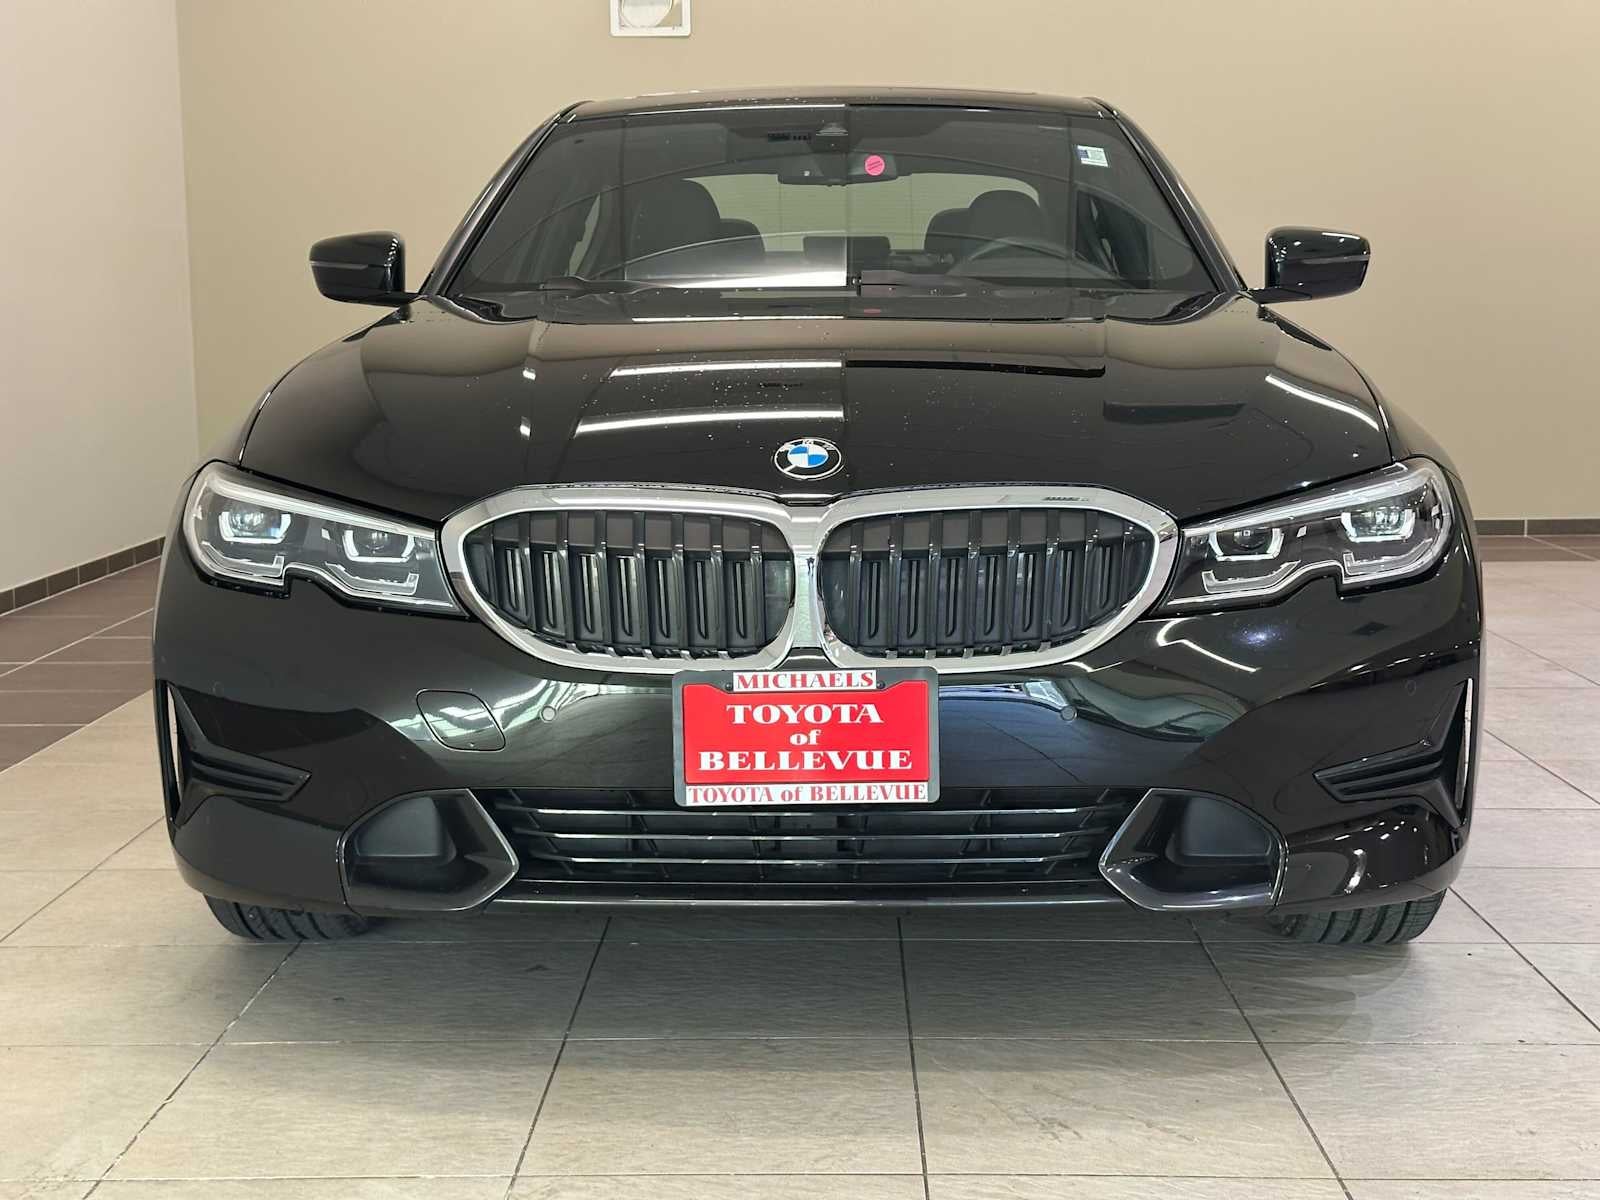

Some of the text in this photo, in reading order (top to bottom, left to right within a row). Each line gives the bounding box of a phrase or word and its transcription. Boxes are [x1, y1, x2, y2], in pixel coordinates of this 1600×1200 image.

[737, 672, 873, 689] MICHAELS
[727, 704, 884, 724] TOYOTA
[790, 729, 821, 745] of
[698, 750, 912, 771] BELLEVUE
[688, 784, 926, 803] TOYOTA of BELLEVUE
